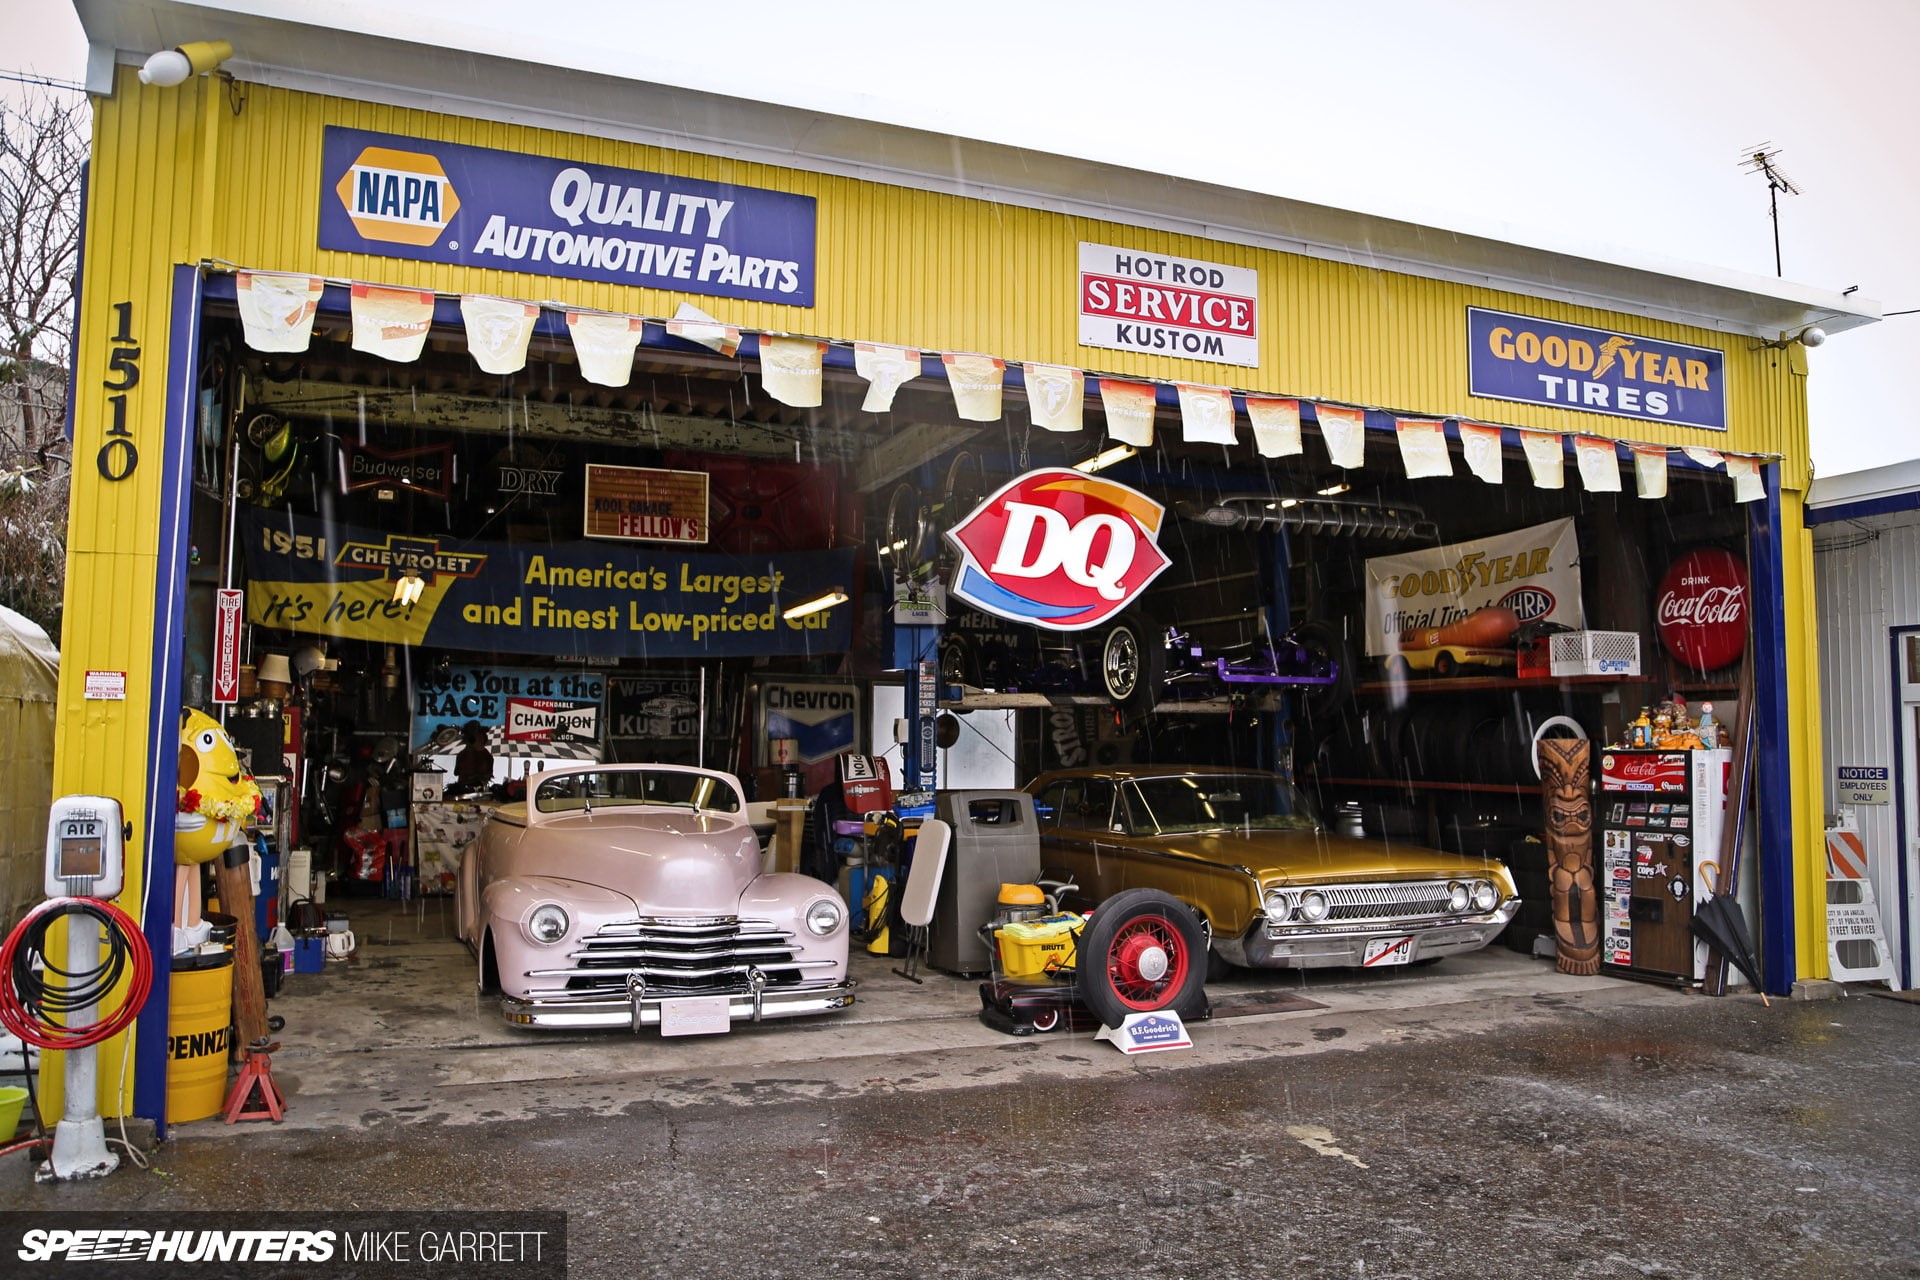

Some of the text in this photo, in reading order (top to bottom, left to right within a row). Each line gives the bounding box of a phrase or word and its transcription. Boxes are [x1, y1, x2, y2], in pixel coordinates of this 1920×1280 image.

[358, 171, 440, 222] NAPA
[550, 167, 735, 239] QUALITY
[473, 215, 800, 293] AUTOMOTIVE PARTS
[1116, 254, 1224, 288] HOT ROD
[1087, 279, 1250, 331] SERVICE
[1116, 323, 1225, 357] KUSTOM
[97, 301, 141, 482] 1510
[1538, 373, 1669, 416] TIRES
[352, 455, 443, 481] Budweiser
[620, 514, 699, 539] FELLOW'S
[263, 527, 326, 561] 1951
[990, 501, 1137, 601] DQ
[351, 546, 471, 573] CHEVROLET
[525, 555, 785, 603] America's Largest
[1681, 575, 1710, 586] DRINK
[221, 597, 239, 607] FIRE
[263, 586, 418, 624] it's here!
[1498, 590, 1549, 619] NHRA
[1658, 585, 1746, 627] Coca-Cola
[463, 597, 521, 626] and
[532, 596, 619, 630] Finest
[630, 606, 776, 640] Low-priced
[1384, 607, 1436, 635] Official
[1440, 604, 1468, 627] Tire
[223, 607, 233, 689] EXTINGUISHER
[471, 670, 520, 694] You
[526, 677, 554, 697] at
[559, 674, 602, 699] the
[618, 679, 670, 697] WEST
[767, 685, 855, 710] Chevron
[418, 693, 499, 719] RACE
[533, 701, 574, 709] DEPENDABLE
[515, 713, 592, 729] CHAMPION
[530, 732, 551, 741] SPAR
[1840, 781, 1887, 790] EMPLOYEES
[1842, 768, 1884, 779] NOTICE
[1852, 793, 1873, 801] ONLY
[67, 823, 96, 835] AIR
[1829, 925, 1876, 935] STREET SERVICES
